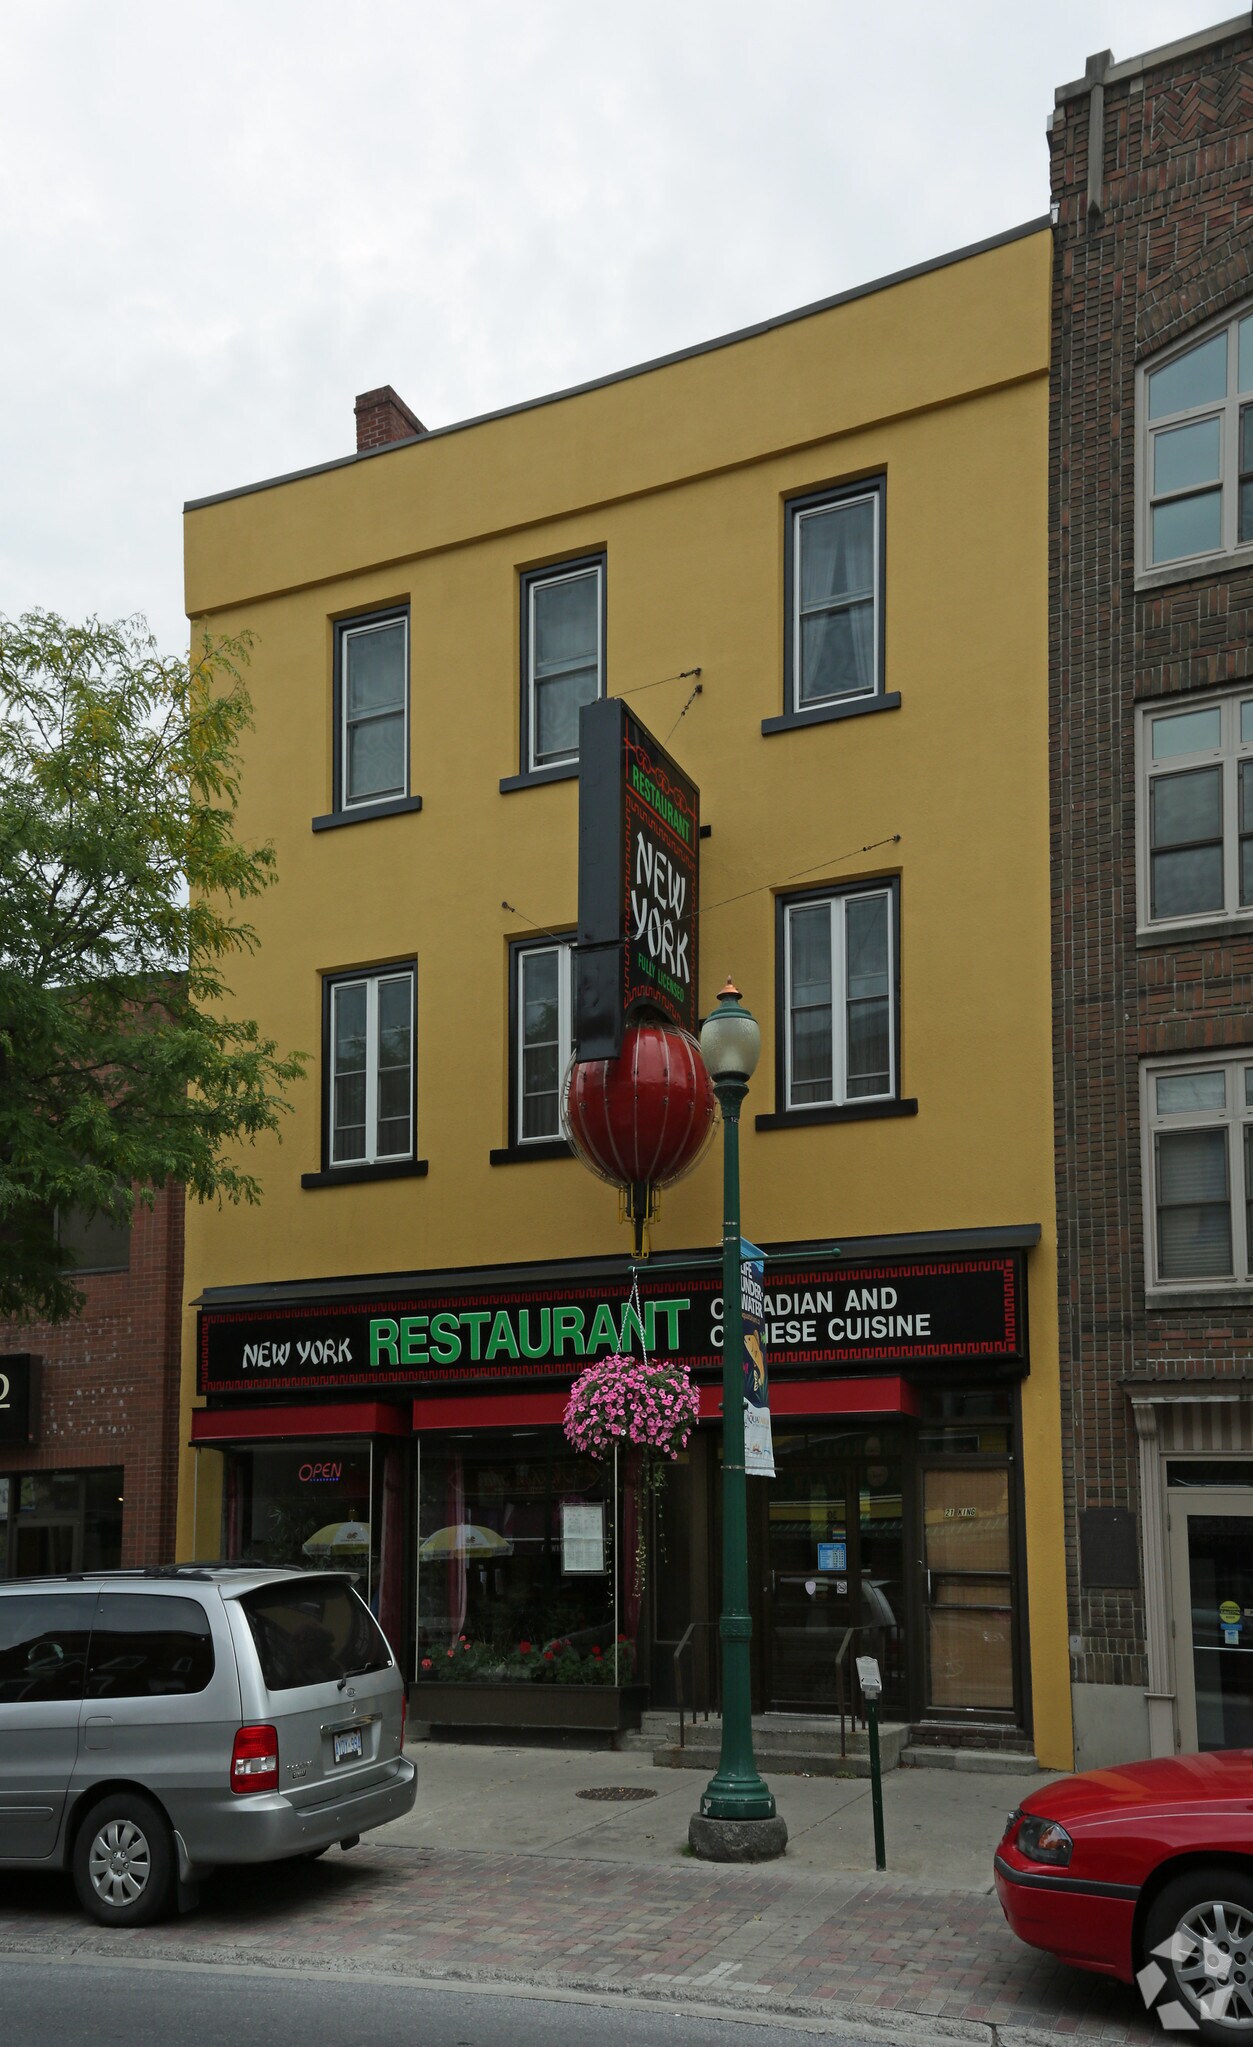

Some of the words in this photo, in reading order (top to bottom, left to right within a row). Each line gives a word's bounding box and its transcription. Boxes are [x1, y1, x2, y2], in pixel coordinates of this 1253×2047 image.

[632, 764, 690, 843] RESTAURANT
[636, 831, 686, 920] NEW
[630, 890, 690, 984] YORK
[638, 952, 656, 978] FULLY
[657, 969, 684, 1002] LICENSED
[741, 1261, 753, 1279] LIFE
[710, 1291, 833, 1320] CADIAN
[844, 1287, 898, 1312] AND
[741, 1293, 763, 1318] WATER
[369, 1299, 690, 1366] RESTAURANT
[828, 1314, 931, 1341] CUISINE
[242, 1341, 291, 1368] NEW
[296, 1337, 353, 1366] YORK
[298, 1463, 342, 1481] OPEN
[957, 1507, 976, 1517] KING
